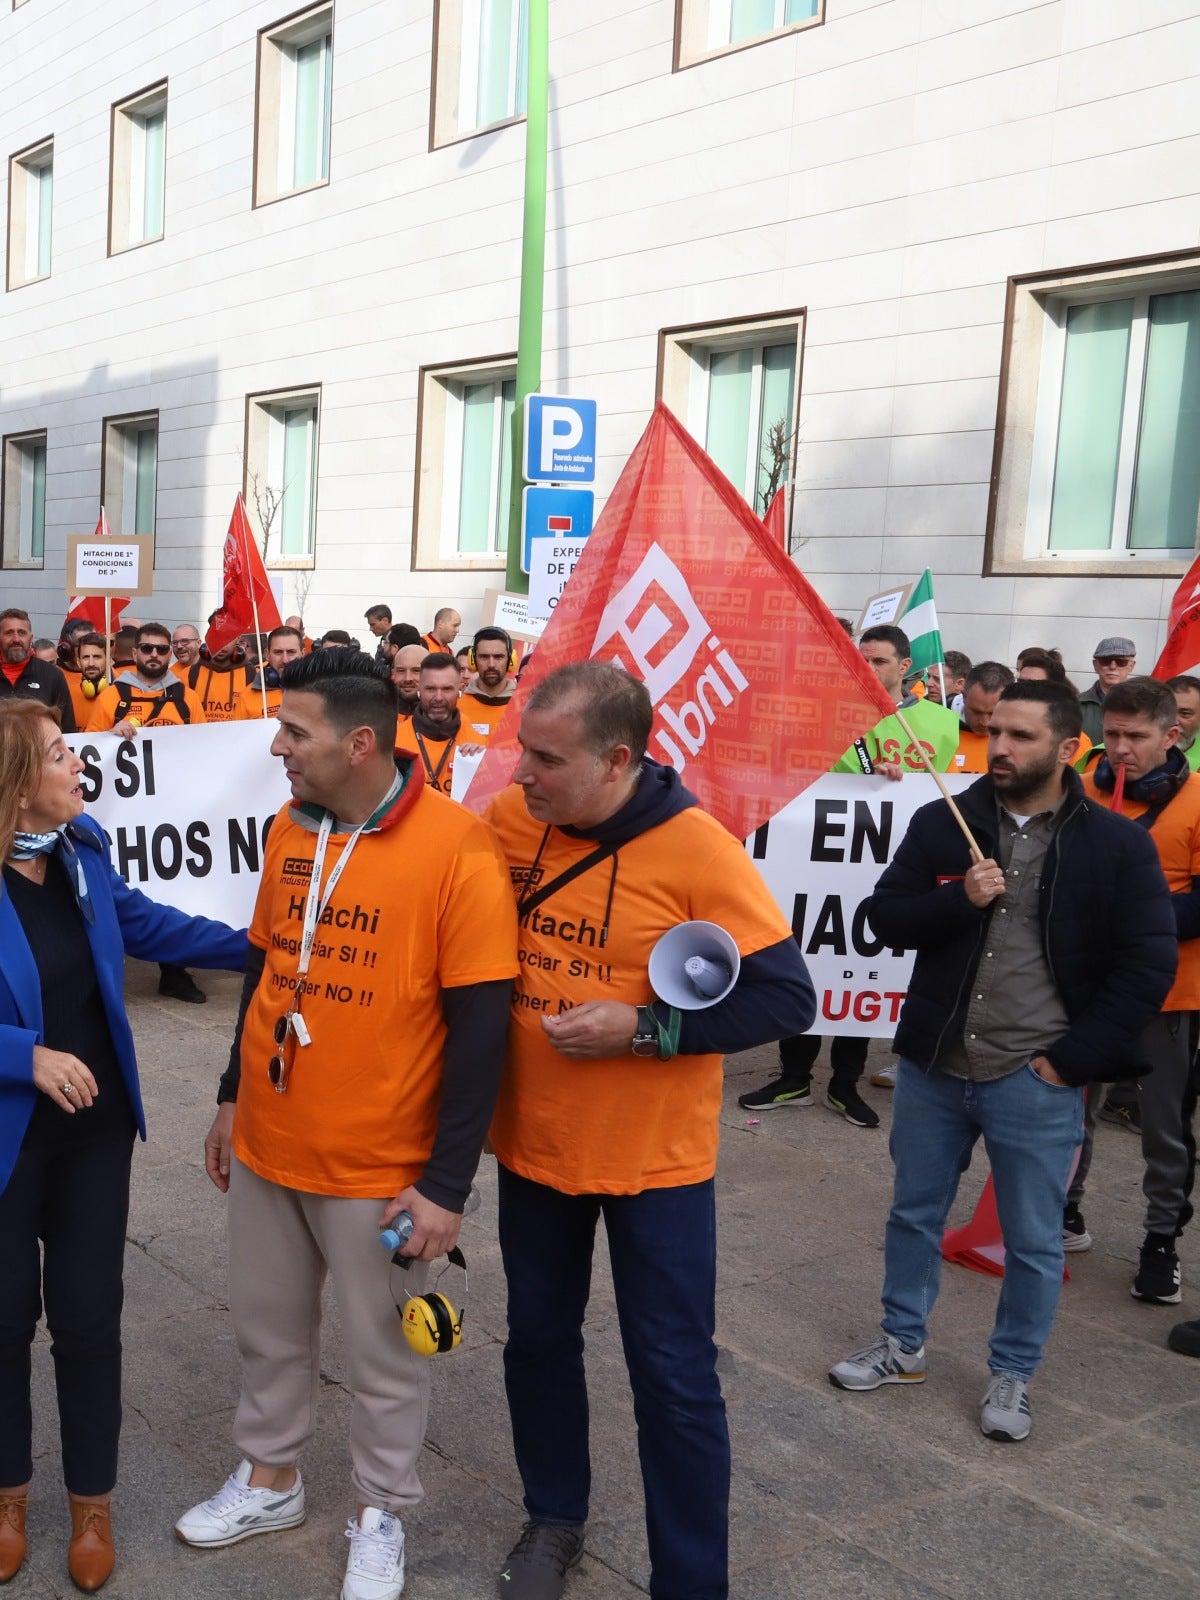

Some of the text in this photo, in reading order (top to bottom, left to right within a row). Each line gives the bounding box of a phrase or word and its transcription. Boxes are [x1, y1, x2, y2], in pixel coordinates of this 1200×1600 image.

[540, 405, 583, 472] P
[548, 564, 564, 575] DE
[114, 739, 156, 798] SI
[857, 747, 872, 774] umbro
[810, 799, 894, 864] EN
[339, 945, 358, 964] SI
[568, 959, 589, 979] SI
[325, 983, 352, 1003] NO
